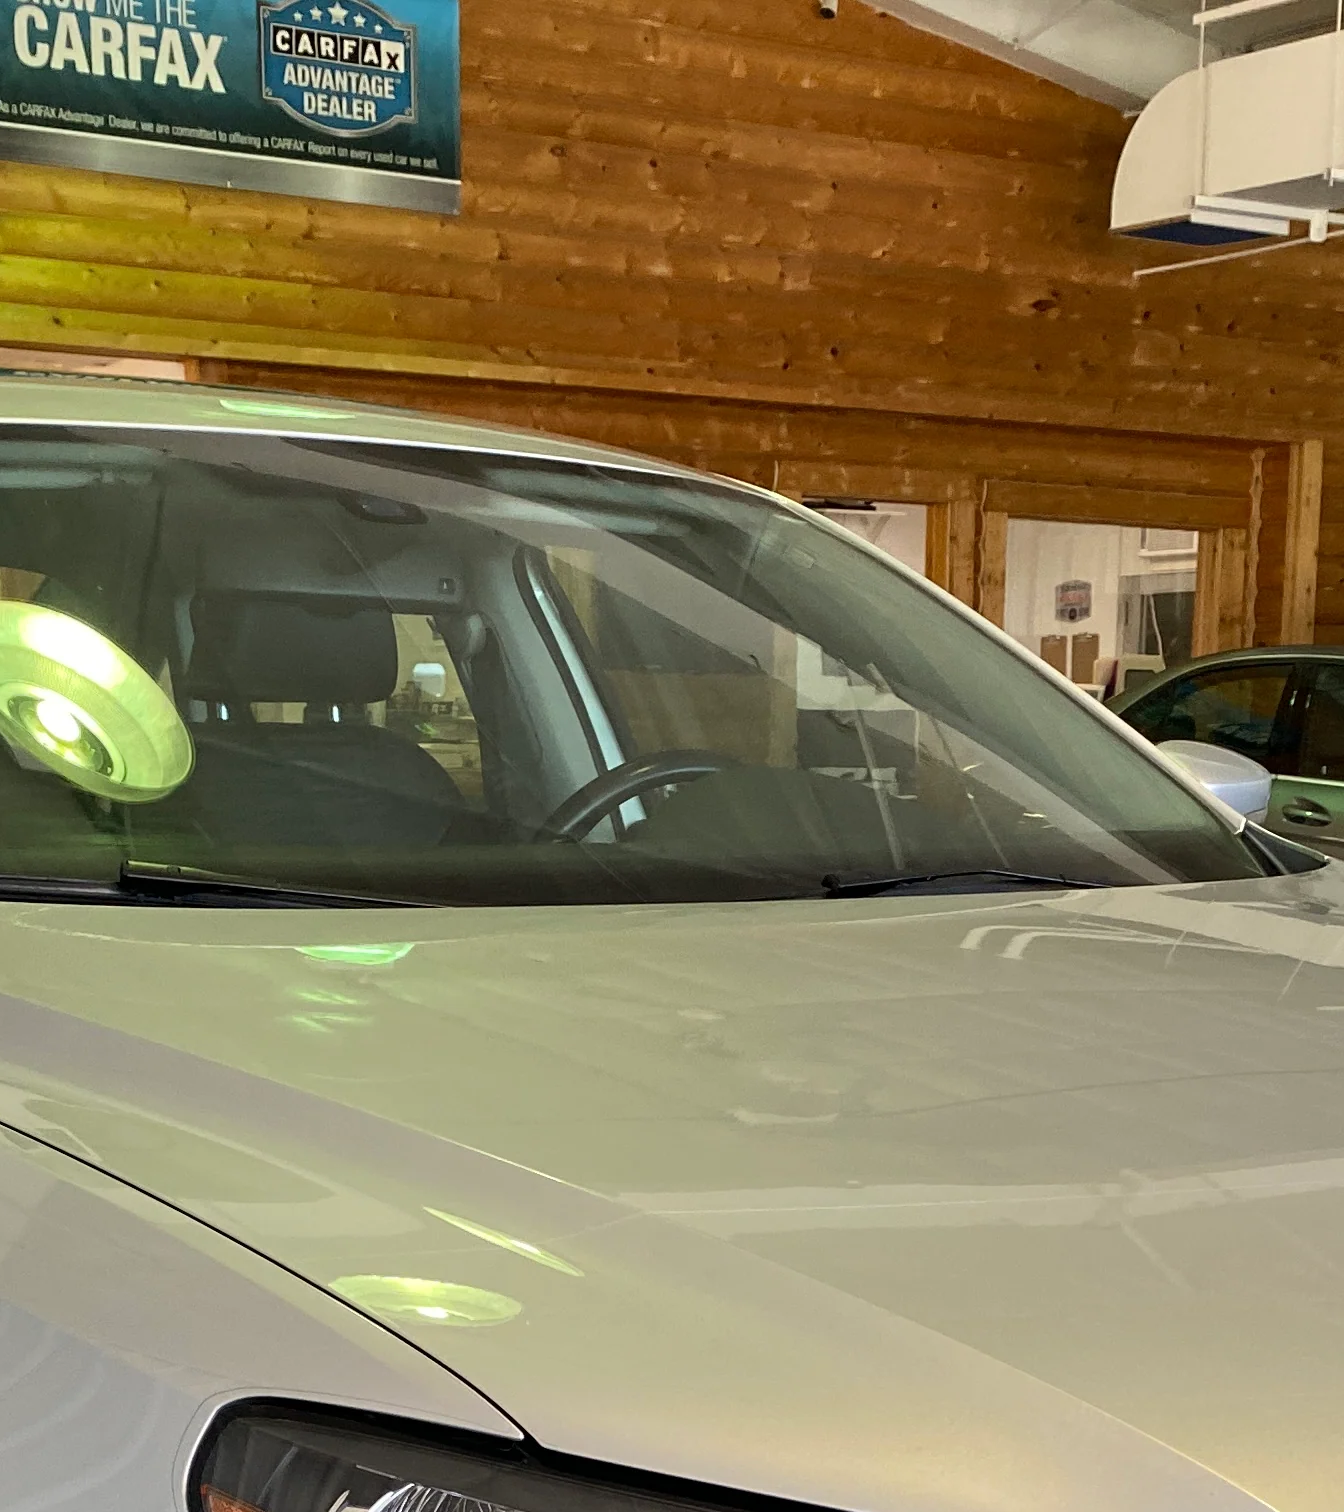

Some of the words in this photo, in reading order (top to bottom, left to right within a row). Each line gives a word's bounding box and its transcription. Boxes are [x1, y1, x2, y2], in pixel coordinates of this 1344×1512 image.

[13, 4, 227, 94] CARFAX
[275, 29, 401, 71] CARFAX
[283, 63, 396, 100] ADVANTAGE
[303, 91, 377, 123] DEALER
